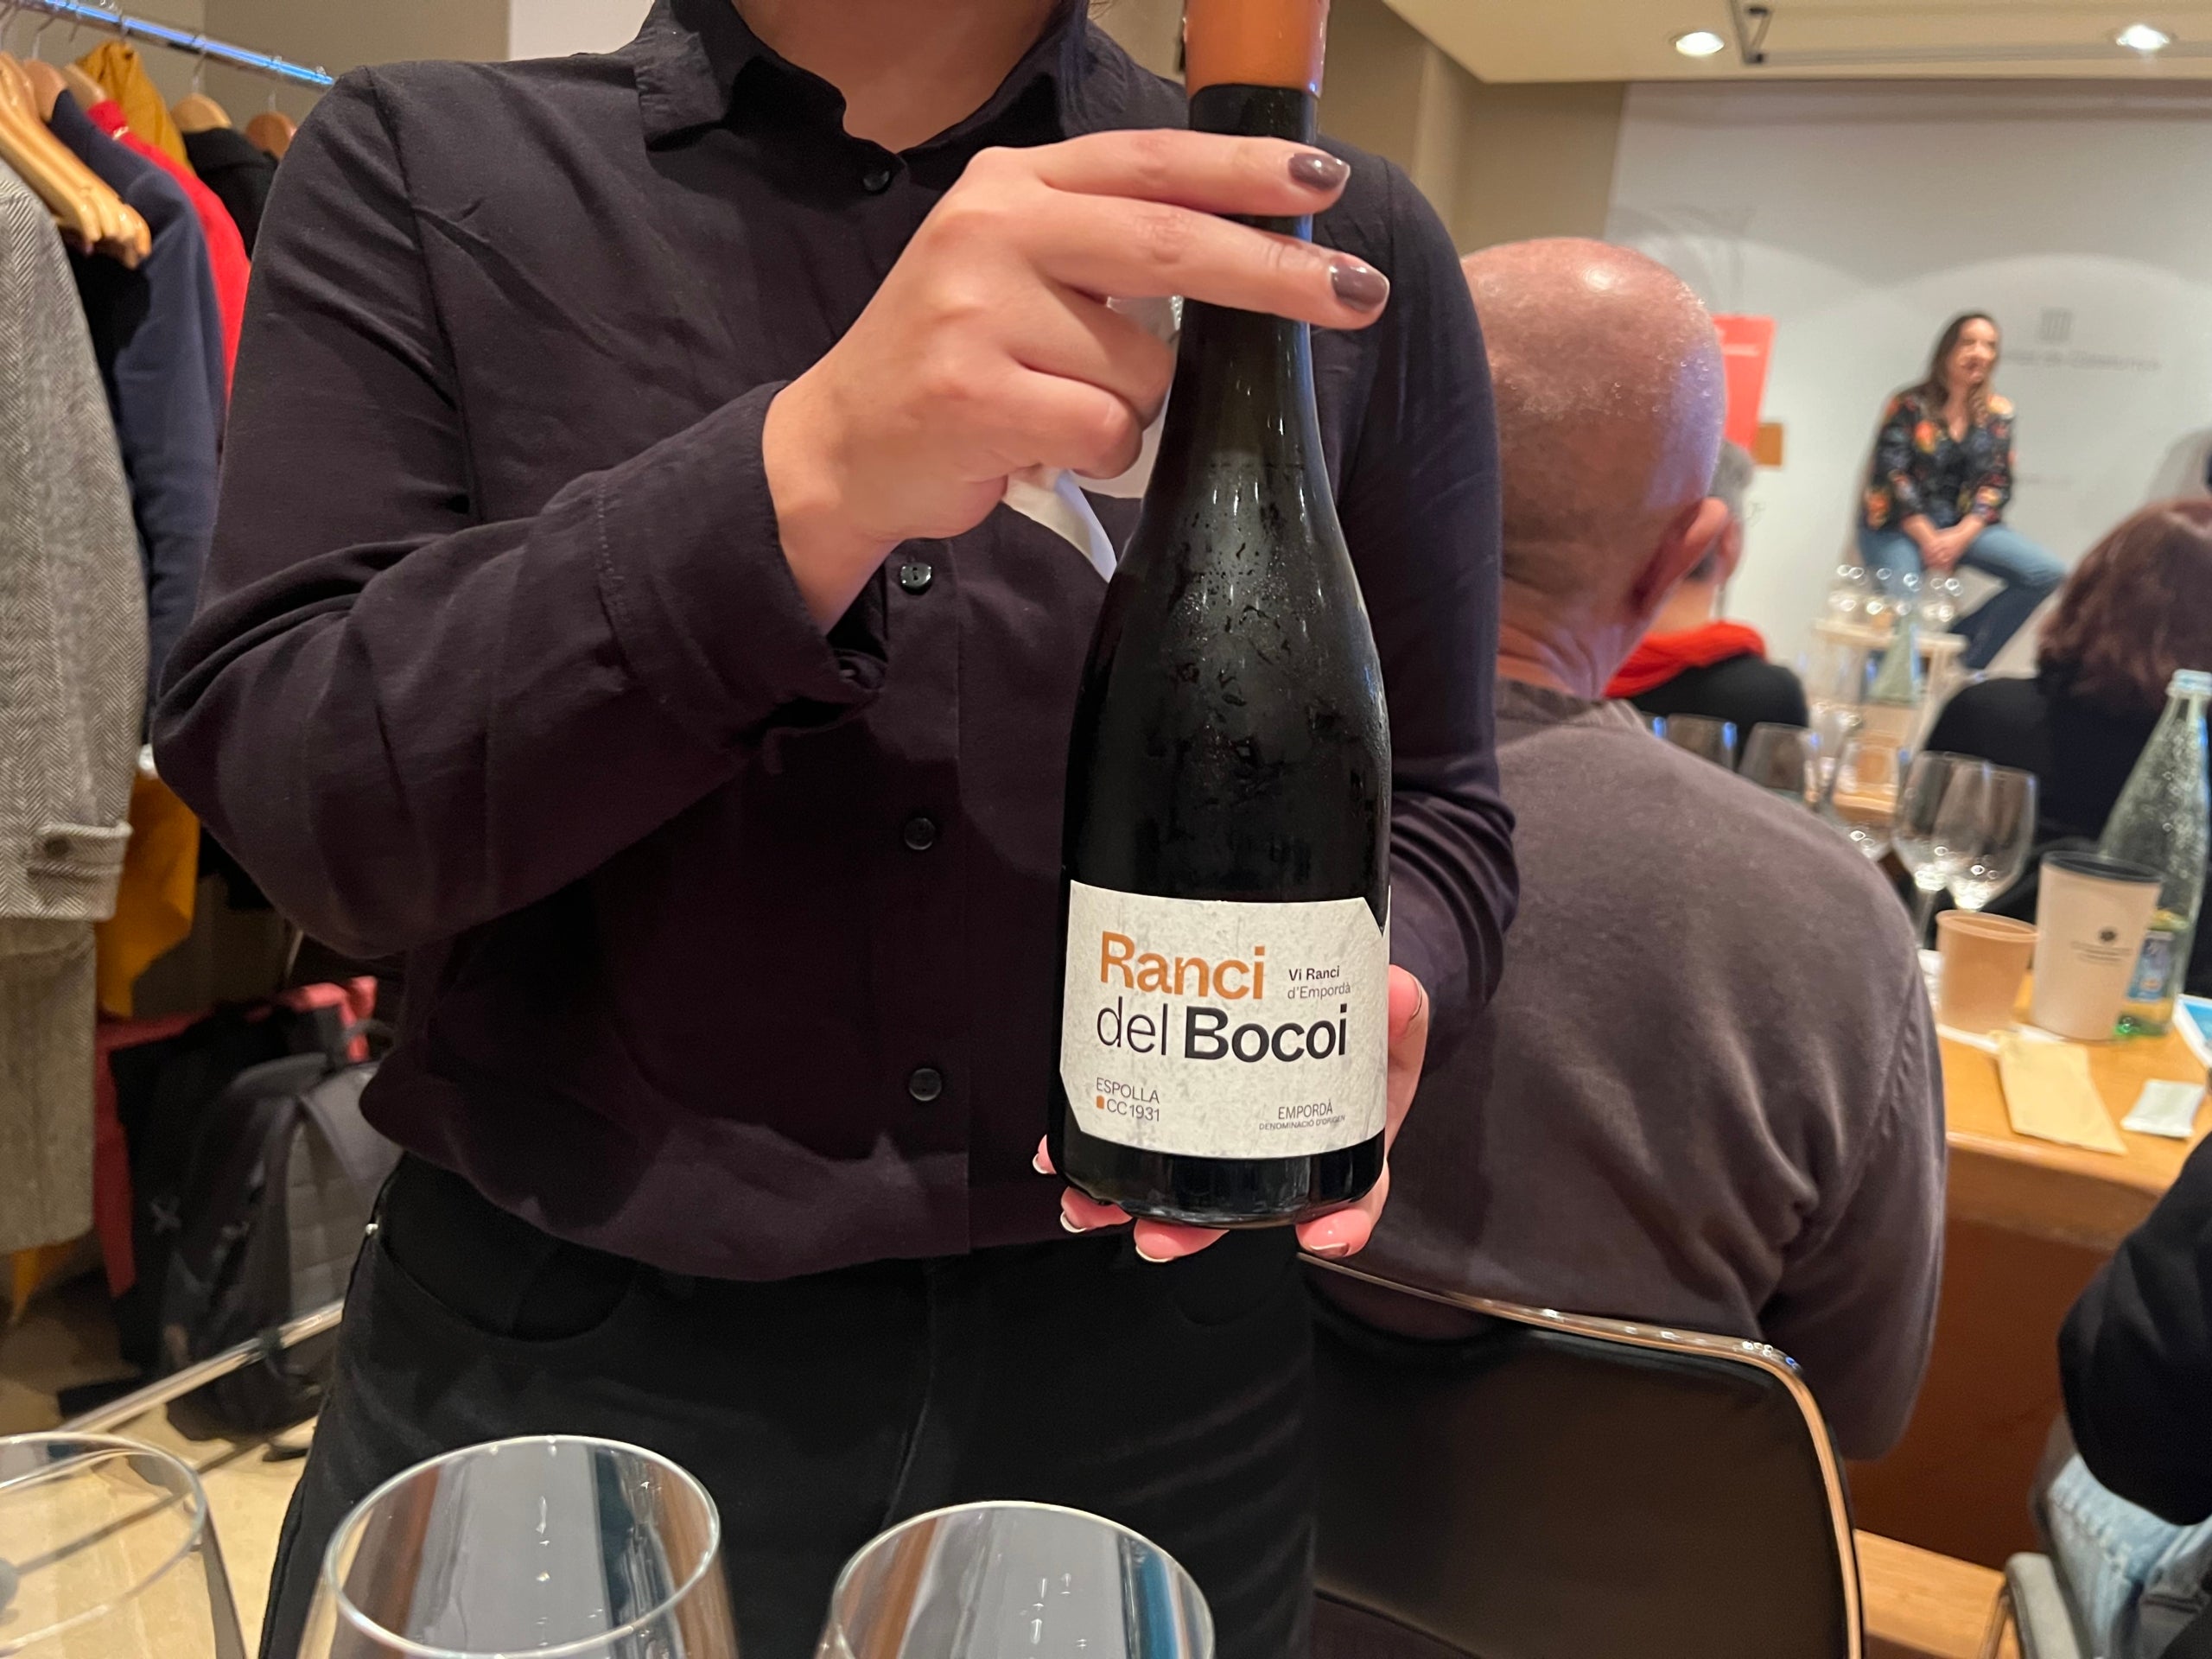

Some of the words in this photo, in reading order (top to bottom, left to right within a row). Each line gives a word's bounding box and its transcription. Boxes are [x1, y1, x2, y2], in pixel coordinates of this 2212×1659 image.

[1100, 931, 1266, 1000] Ranci
[1288, 968, 1302, 982] Vi
[1306, 965, 1340, 981] Ranci
[1287, 982, 1351, 1000] d'Empordà
[1096, 996, 1168, 1056] del
[1185, 1003, 1347, 1062] Bocoi
[1096, 1077, 1160, 1104] ESPOLLA
[1278, 1098, 1333, 1120] EMPORDÀ
[1259, 1120, 1314, 1131] DENOMINACIÓ
